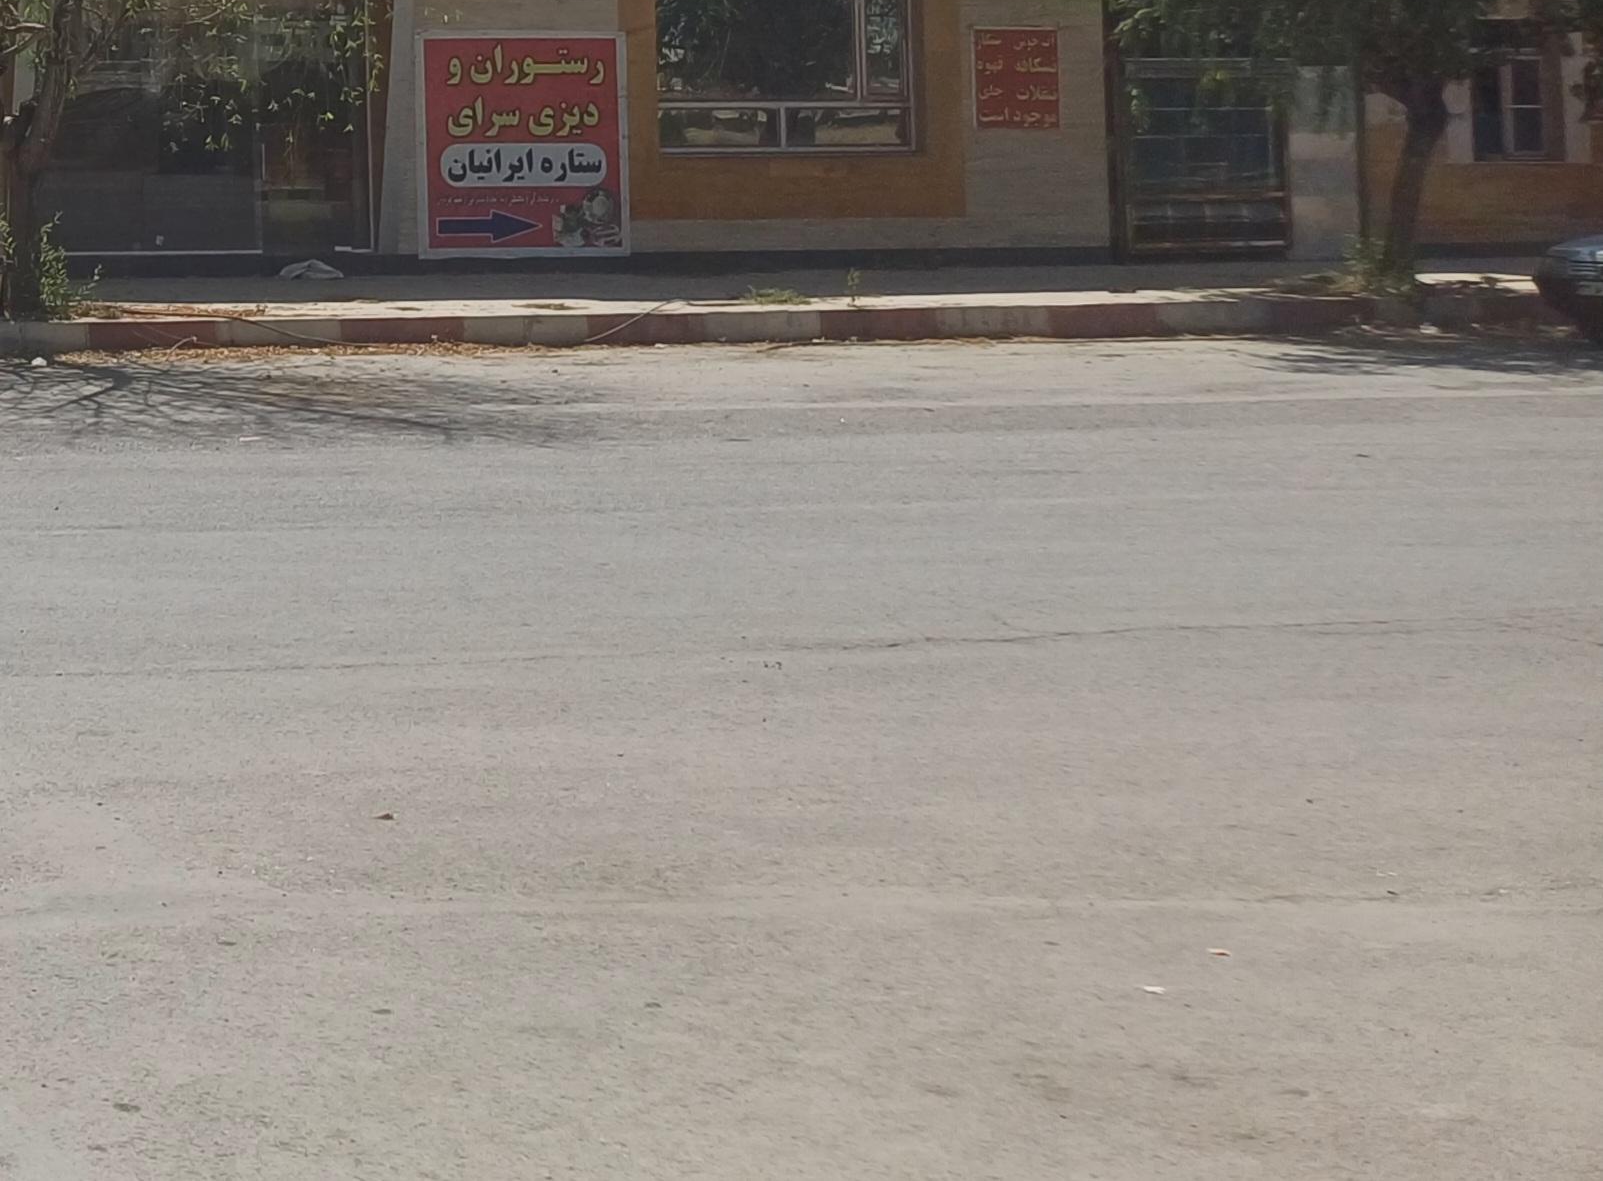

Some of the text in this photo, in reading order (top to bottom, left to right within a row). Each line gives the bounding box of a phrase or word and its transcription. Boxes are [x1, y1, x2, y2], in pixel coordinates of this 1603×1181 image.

[447, 43, 604, 85] رستوران و
[447, 95, 599, 137] دیزی سرای
[447, 147, 602, 183] ستاره ایرانیان
